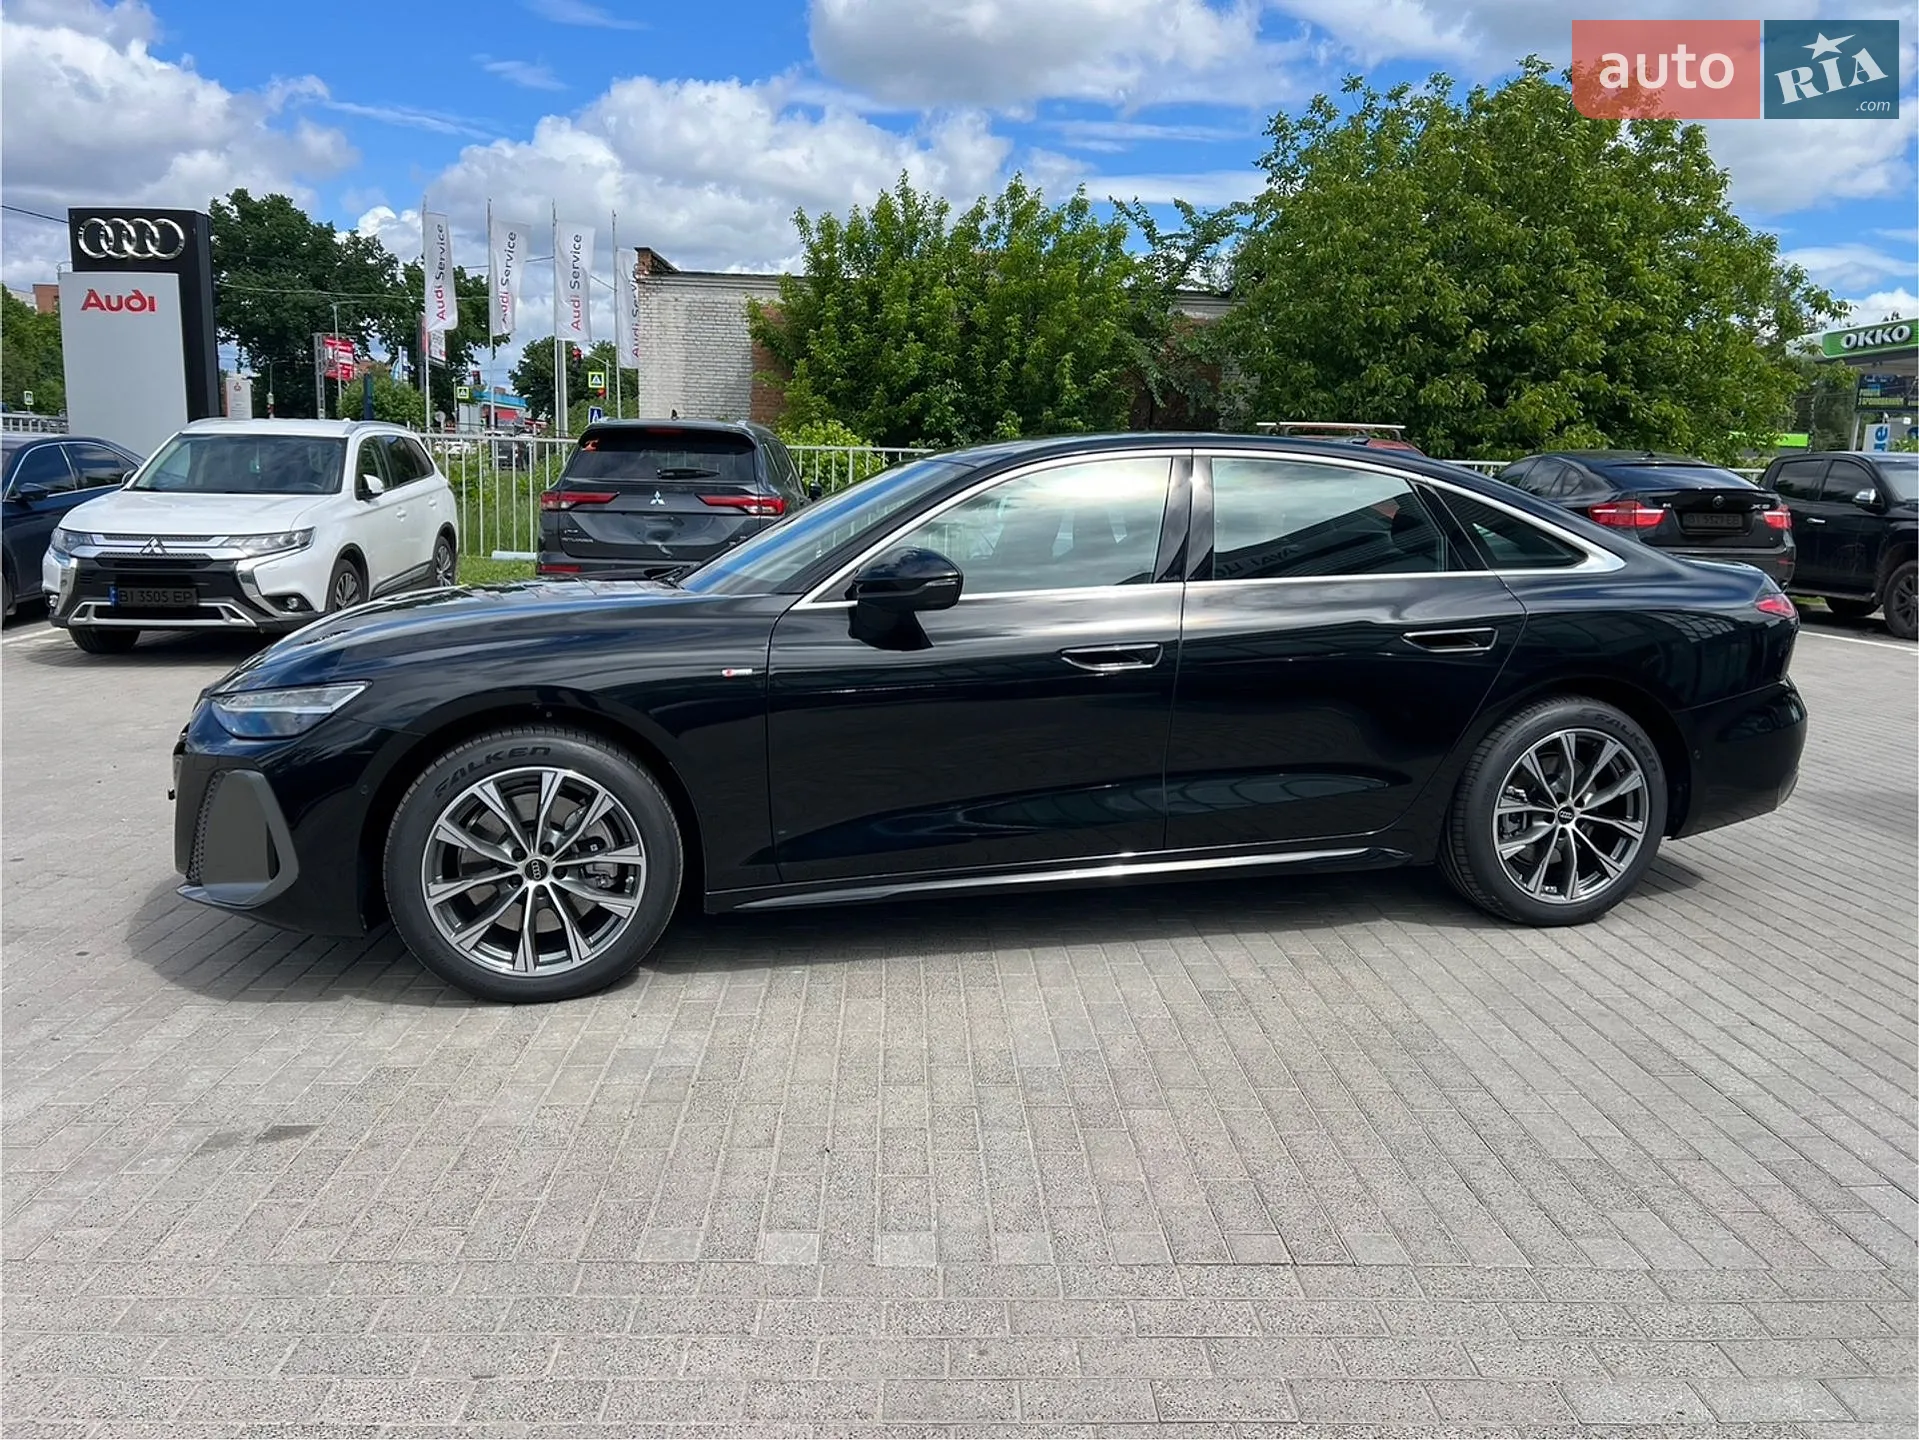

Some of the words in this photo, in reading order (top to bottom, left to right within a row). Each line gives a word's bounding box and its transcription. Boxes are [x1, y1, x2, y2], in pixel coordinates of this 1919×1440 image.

[435, 224, 446, 281] Service
[500, 231, 517, 287] Service
[570, 234, 582, 290] Service
[80, 288, 156, 312] Audi
[434, 285, 446, 321] Audi
[570, 295, 581, 331] Audi
[1840, 325, 1911, 349] OKKO
[119, 591, 134, 602] BI
[137, 591, 169, 602] 3505
[173, 591, 193, 602] EP
